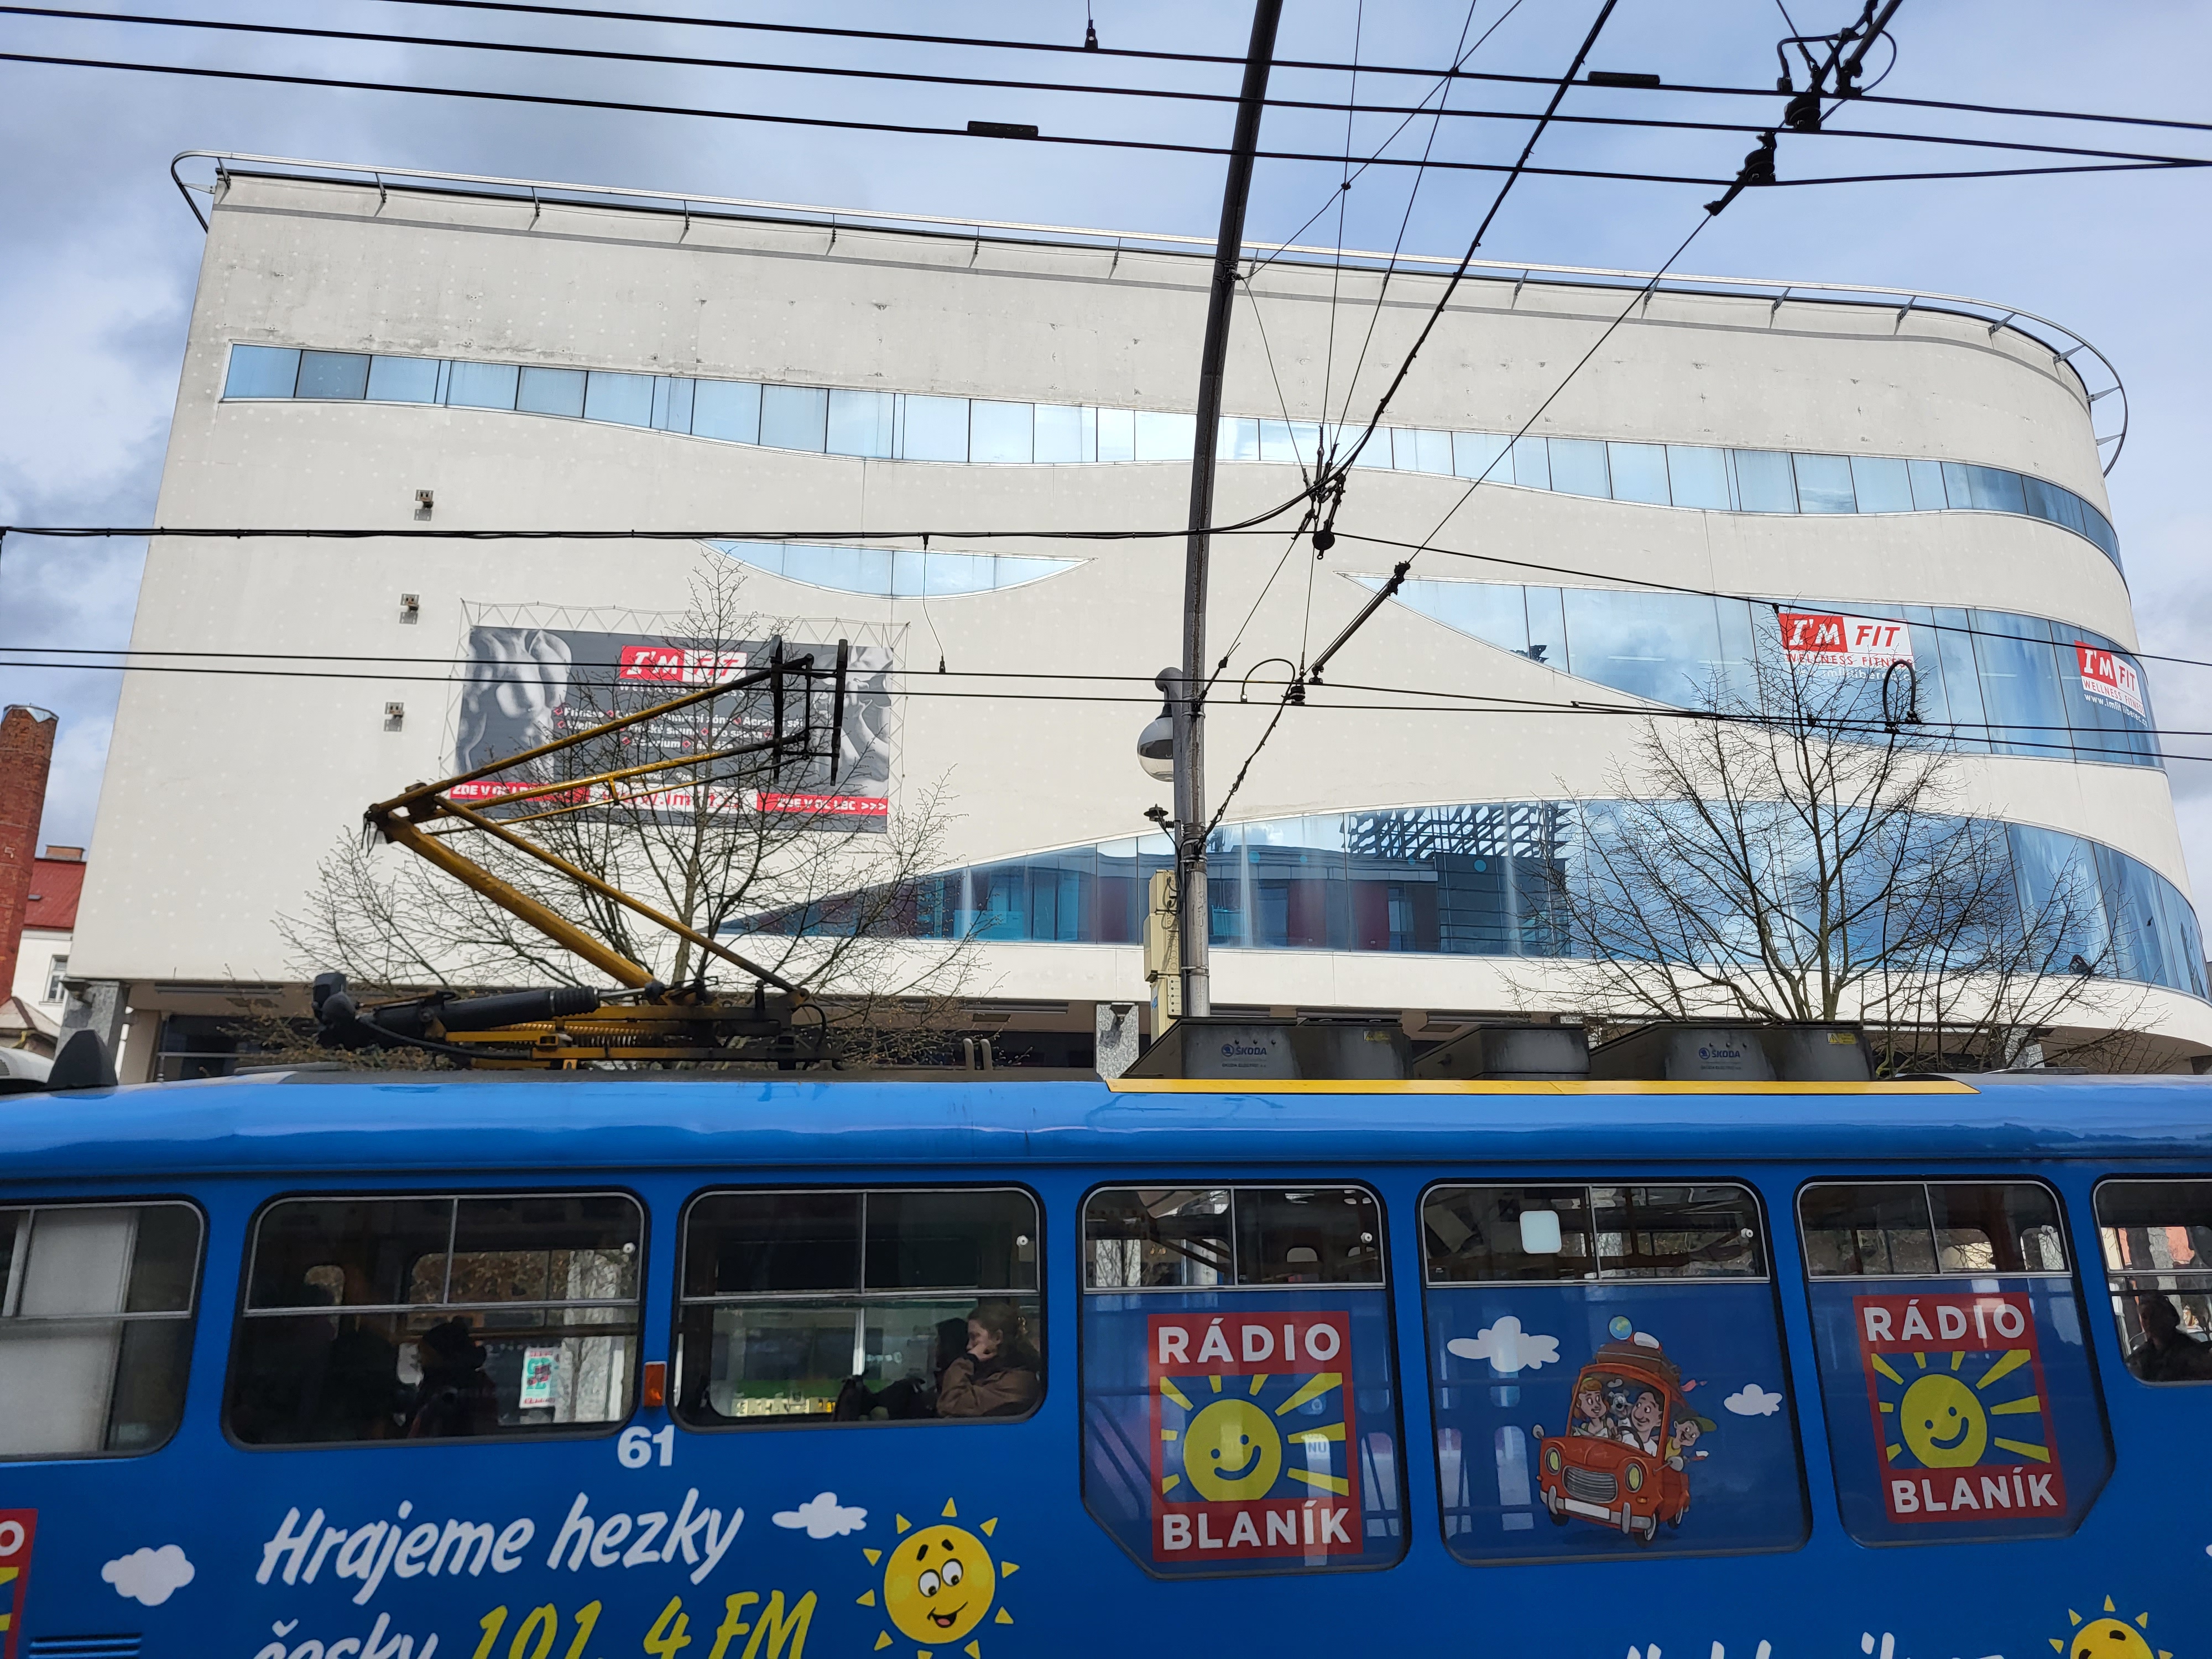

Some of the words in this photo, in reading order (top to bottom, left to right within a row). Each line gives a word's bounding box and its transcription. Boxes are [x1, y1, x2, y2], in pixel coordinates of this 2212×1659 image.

[1788, 619, 1840, 646] I'M
[1855, 625, 1901, 647] FIT
[626, 651, 679, 676] I'M
[1786, 653, 1853, 665] WELLNESS
[2084, 649, 2114, 680] I'M
[2119, 665, 2135, 692] FIT
[2083, 679, 2122, 701] WELLNESS
[452, 785, 478, 795] ZDE
[481, 785, 491, 795] V
[1235, 1045, 1267, 1055] ŠKODA
[1157, 1318, 1340, 1364] RÁDIO
[1864, 1299, 2025, 1342] RÁDIO
[617, 1425, 675, 1469] 61
[1891, 1467, 2058, 1514] BLANÍK
[255, 1500, 535, 1605] Hrajeme
[546, 1488, 745, 1585] hezky
[1162, 1500, 1352, 1551] BLANÍK
[708, 1589, 818, 1659] FM
